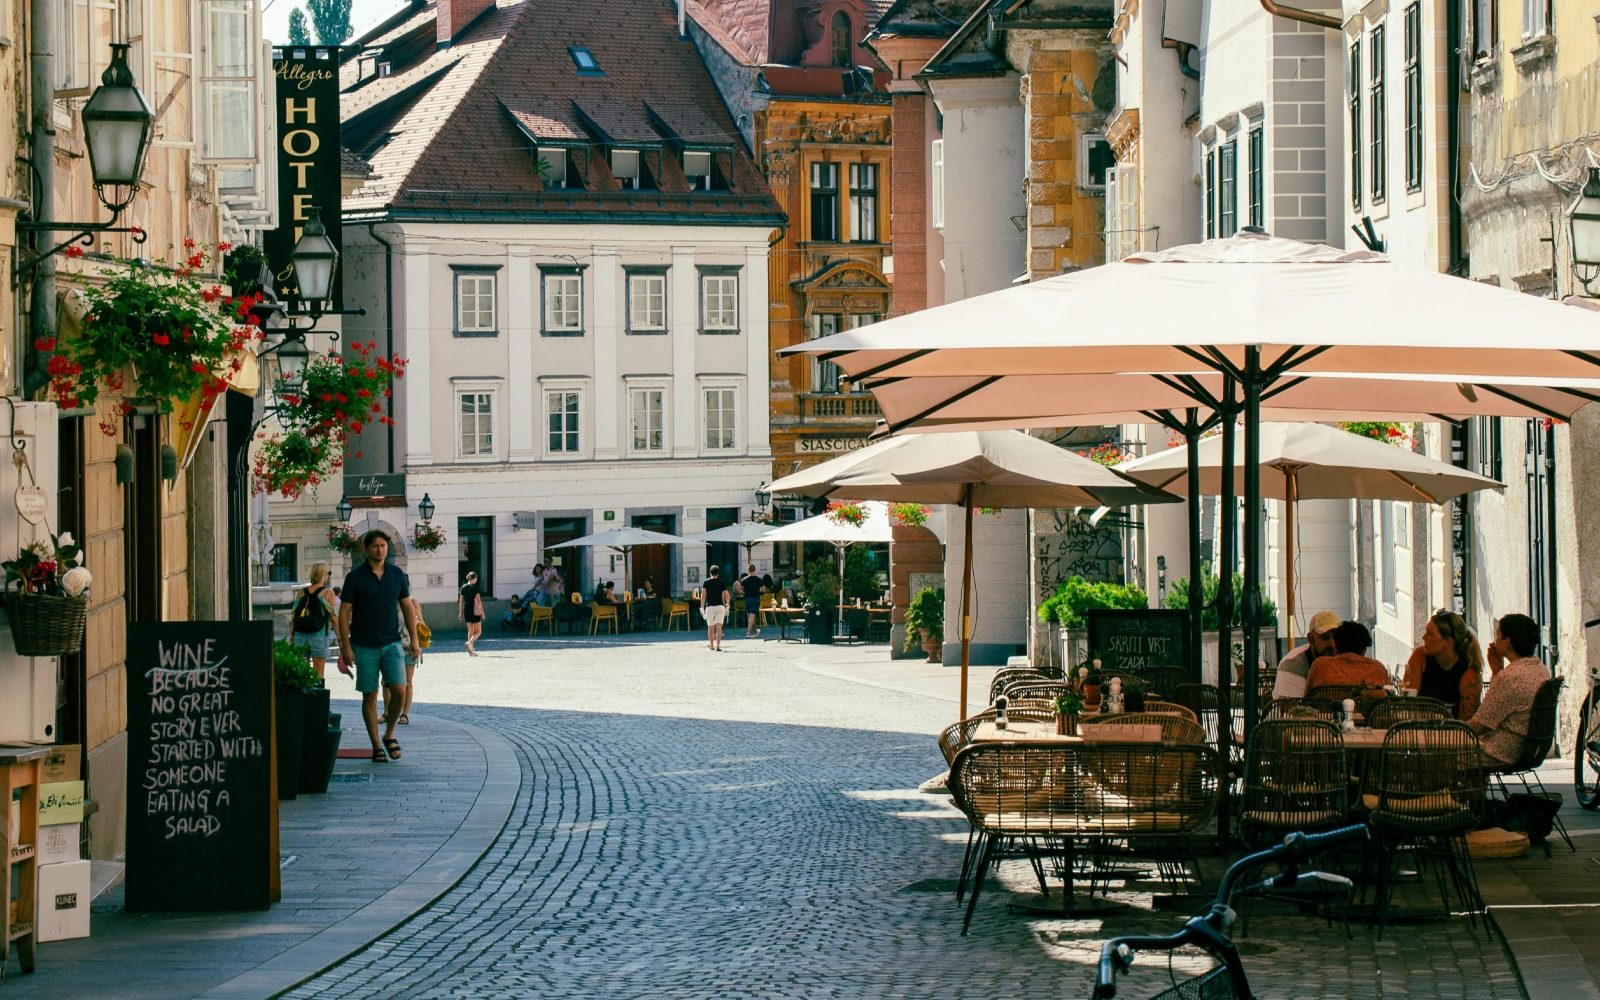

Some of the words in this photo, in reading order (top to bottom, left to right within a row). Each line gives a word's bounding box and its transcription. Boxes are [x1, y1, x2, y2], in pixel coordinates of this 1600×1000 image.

[274, 60, 334, 90] Allegro
[158, 638, 216, 668] WINE
[1147, 637, 1171, 654] VRT
[148, 667, 231, 695] BECAUSE
[152, 696, 175, 714] NO
[179, 690, 234, 719] GREAT
[150, 717, 196, 740] STORY
[149, 739, 215, 763] STARTED
[220, 736, 262, 758] WITH
[142, 761, 226, 789] SOMEONE
[148, 789, 211, 815] EATING
[216, 790, 230, 806] A
[165, 815, 220, 839] SALAD
